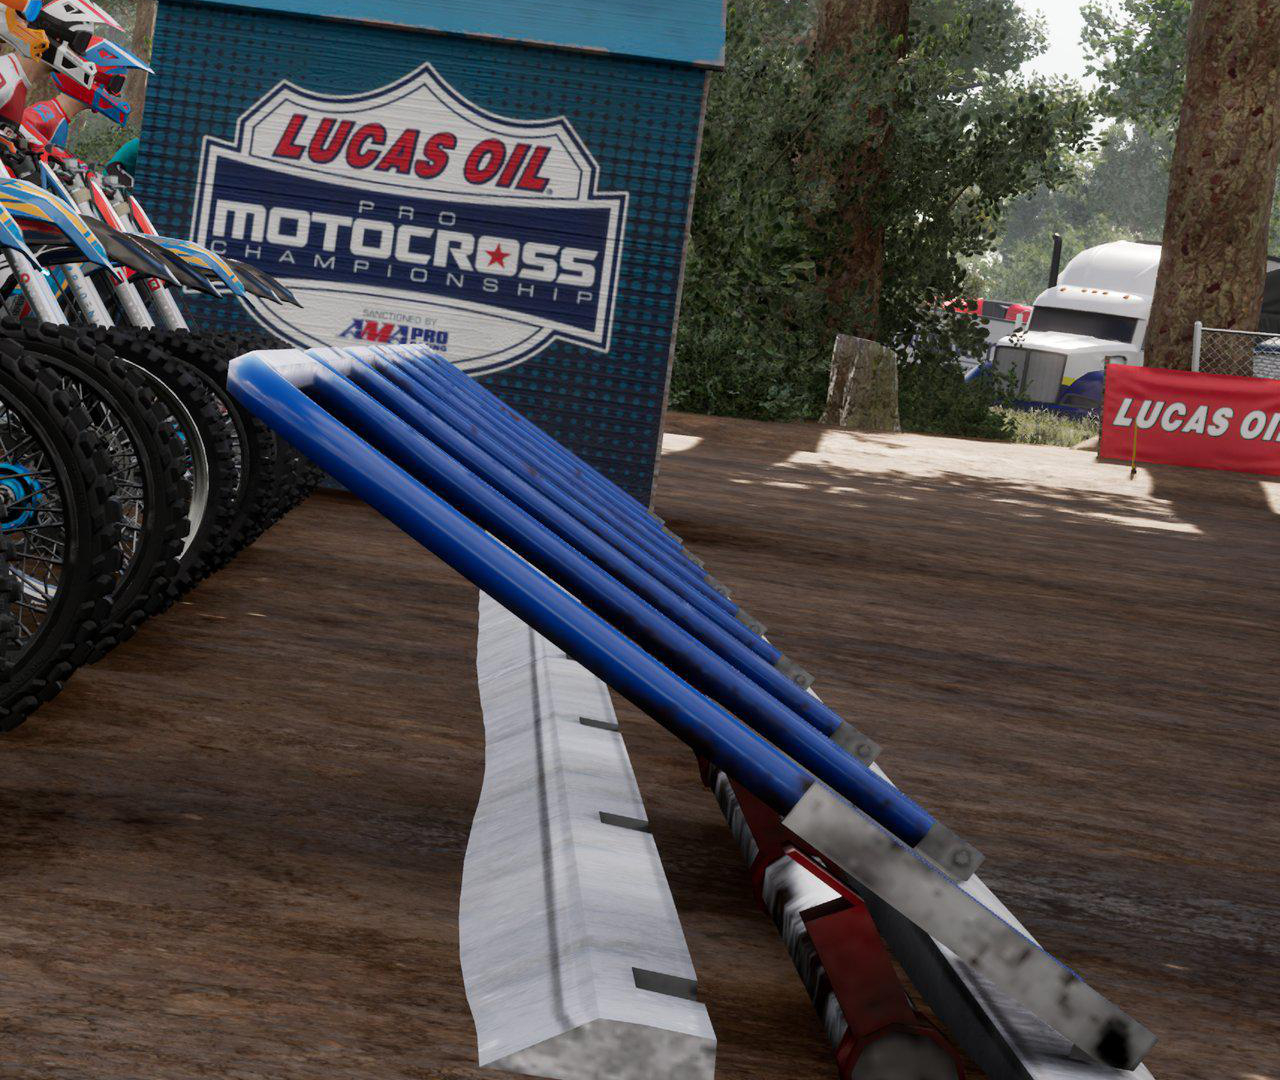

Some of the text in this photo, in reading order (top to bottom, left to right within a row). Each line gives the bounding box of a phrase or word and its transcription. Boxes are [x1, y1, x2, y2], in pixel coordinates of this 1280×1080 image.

[272, 112, 553, 194] LUCAS OIL
[358, 199, 457, 227] PRO
[212, 199, 600, 287] MOTOCROSS
[210, 239, 594, 306] CHAMPIONSHIP
[339, 317, 449, 345] AMA PRO
[362, 308, 438, 327] SANCTIONED BY
[1112, 396, 1235, 438] LUCAS
